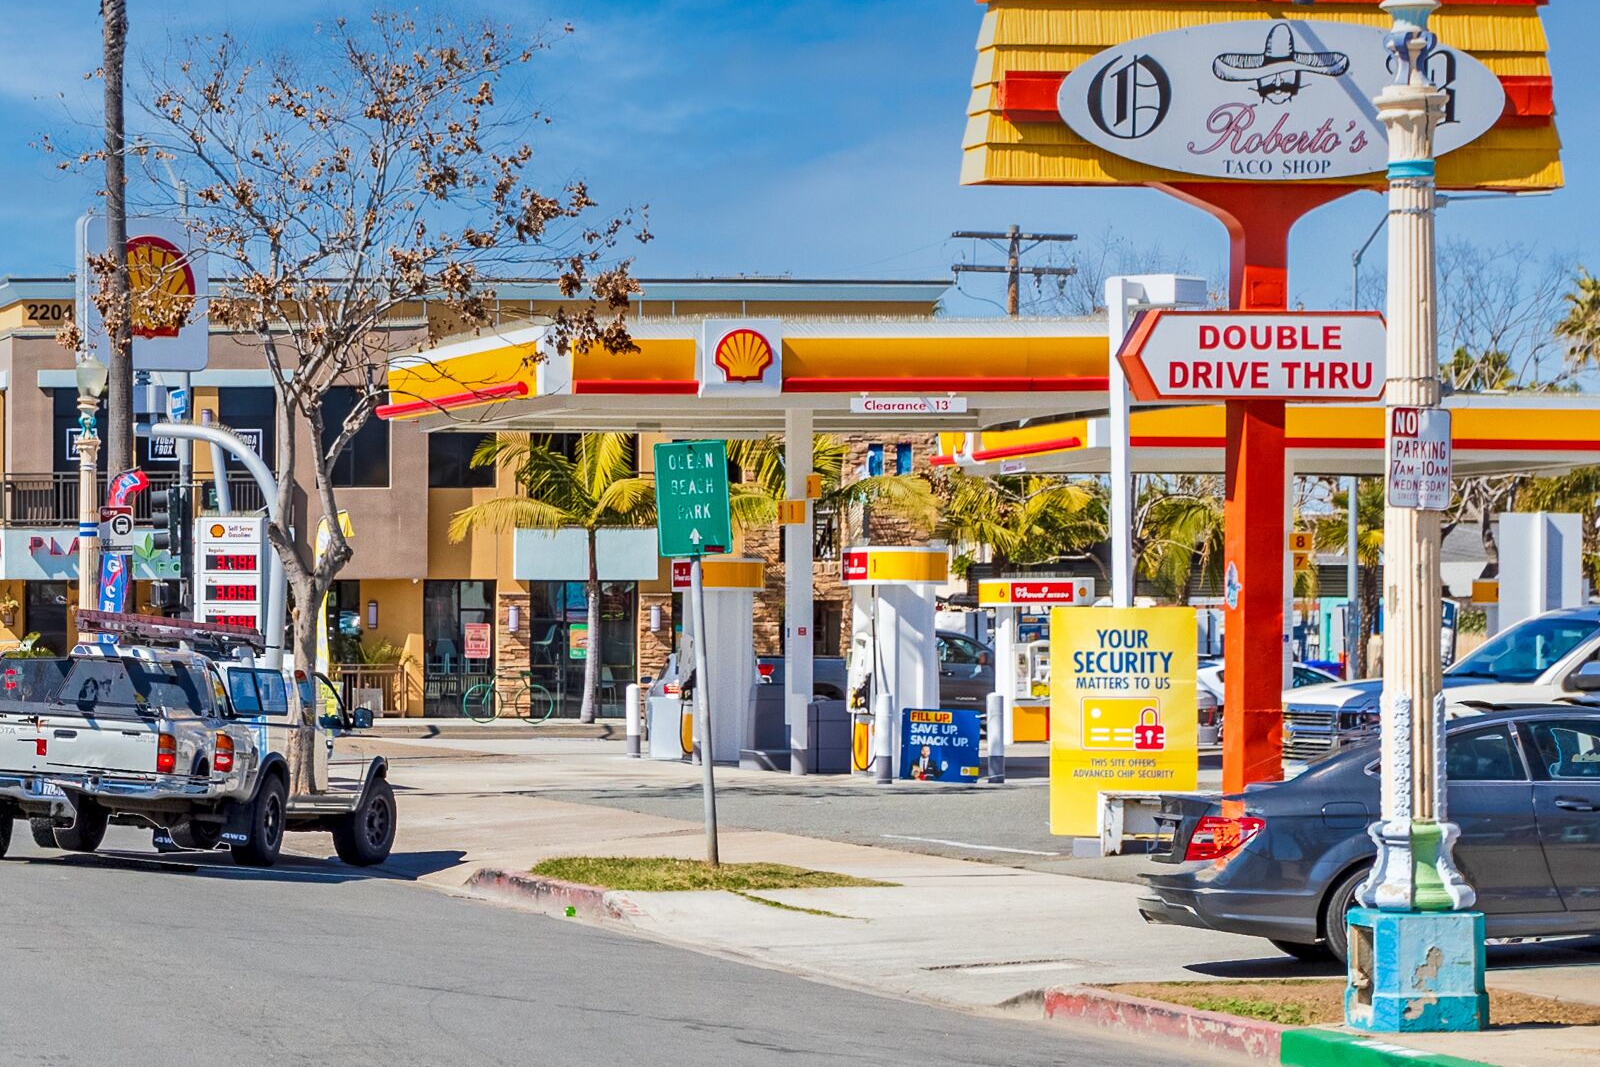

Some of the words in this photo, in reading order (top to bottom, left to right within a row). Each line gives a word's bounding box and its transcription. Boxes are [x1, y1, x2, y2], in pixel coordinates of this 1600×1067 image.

[1187, 102, 1368, 155] Roberto's
[1222, 159, 1273, 175] TACO
[1282, 159, 1332, 175] SHOP
[28, 303, 73, 321] 2204
[1199, 325, 1342, 350] DOUBLE
[1169, 361, 1270, 389] DRIVE
[1281, 361, 1373, 389] THRU
[864, 400, 927, 411] Clearance
[1395, 411, 1418, 435] NO
[156, 436, 175, 445] YOGA
[158, 445, 174, 455] BOX
[1396, 440, 1446, 460] PARKING
[668, 452, 714, 470] OCEAN
[671, 479, 714, 495] BEACH
[1393, 479, 1446, 492] WEDNESDAY
[678, 503, 712, 520] PARK
[1296, 535, 1305, 548] 8
[1295, 556, 1304, 567] 7
[999, 588, 1005, 598] 6
[1096, 629, 1148, 649] YOUR
[1073, 651, 1174, 673] SECURITY
[1076, 677, 1130, 690] MATTERS
[1134, 677, 1150, 690] TO
[1155, 677, 1171, 690] US
[911, 711, 931, 722] FILL
[934, 712, 951, 723] UP.
[910, 723, 938, 734] SAVE
[941, 724, 959, 735] UP.
[910, 734, 949, 746] SNACK
[952, 737, 969, 747] UP.
[1090, 758, 1107, 767] THIS
[1110, 758, 1125, 767] SITE
[1128, 759, 1156, 767] OFFERS
[1073, 769, 1115, 778] ADVANCED
[1117, 769, 1135, 778] CHIP
[1138, 769, 1174, 779] SECURITY
[154, 836, 173, 844] 4W
[221, 832, 248, 841] 4WD
